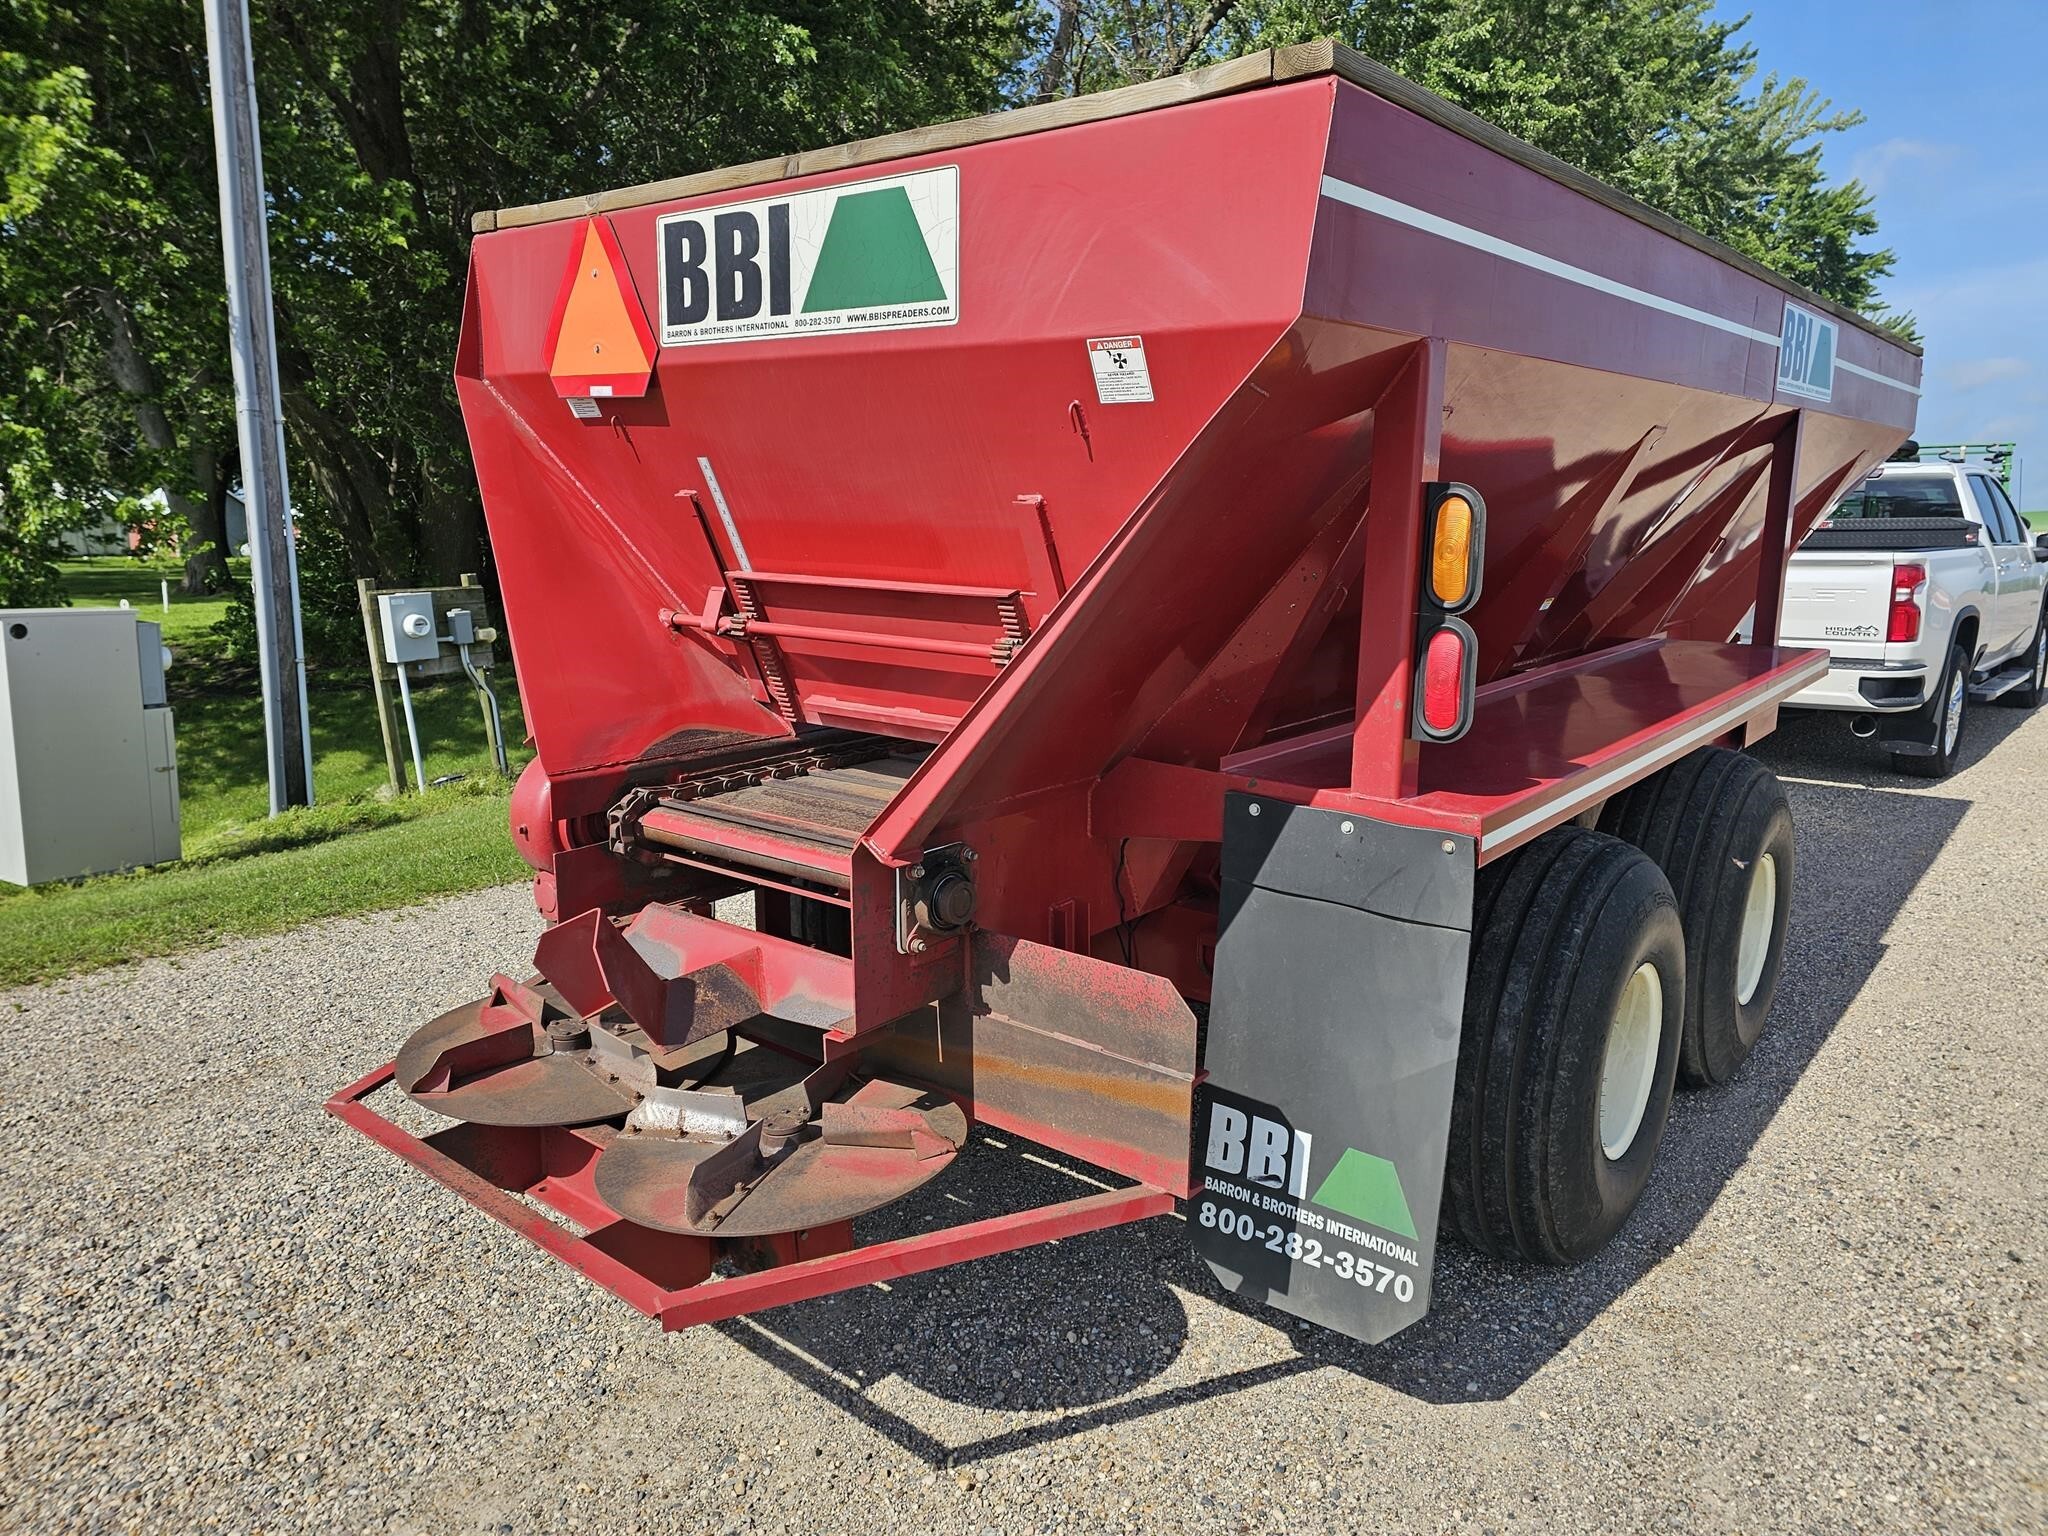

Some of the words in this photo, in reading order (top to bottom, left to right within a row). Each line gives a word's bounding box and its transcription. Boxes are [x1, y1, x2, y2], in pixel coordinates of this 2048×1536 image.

[664, 203, 791, 326] BBI
[667, 328, 693, 338] BARRON
[694, 328, 699, 336] &
[700, 325, 734, 336] BROTHERS
[735, 320, 789, 331] INTERNATIONAL
[794, 316, 841, 328] 800-282-3570
[846, 306, 950, 323] WWW.BBISPREADERS.COM
[1103, 340, 1133, 349] DANGER
[1780, 308, 1813, 384] BBI
[1205, 1102, 1312, 1201] BBI
[1199, 1201, 1414, 1303] 800-282-3570
[1204, 1175, 1251, 1201] BARRON
[1252, 1192, 1261, 1206] &
[1262, 1196, 1325, 1229] BROTHERS
[1326, 1218, 1419, 1267] INTERNATIONAL
